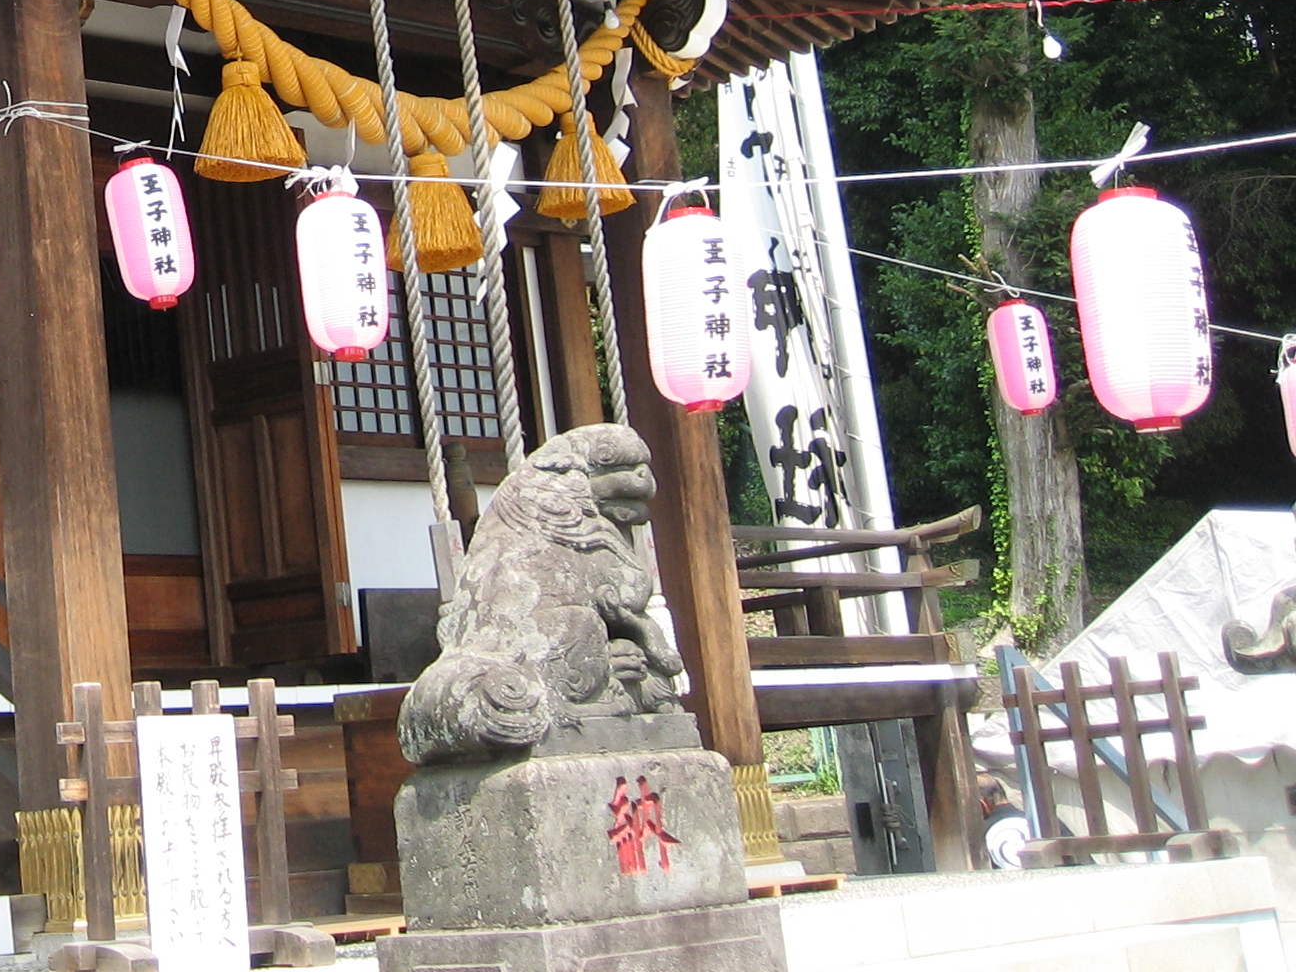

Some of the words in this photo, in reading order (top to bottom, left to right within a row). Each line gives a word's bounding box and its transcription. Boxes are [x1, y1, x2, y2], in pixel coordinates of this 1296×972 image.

[140, 173, 177, 275] 王子神社
[351, 212, 379, 328] 王子神社
[702, 237, 732, 380] 王子神社
[1018, 314, 1047, 394] 王子神社
